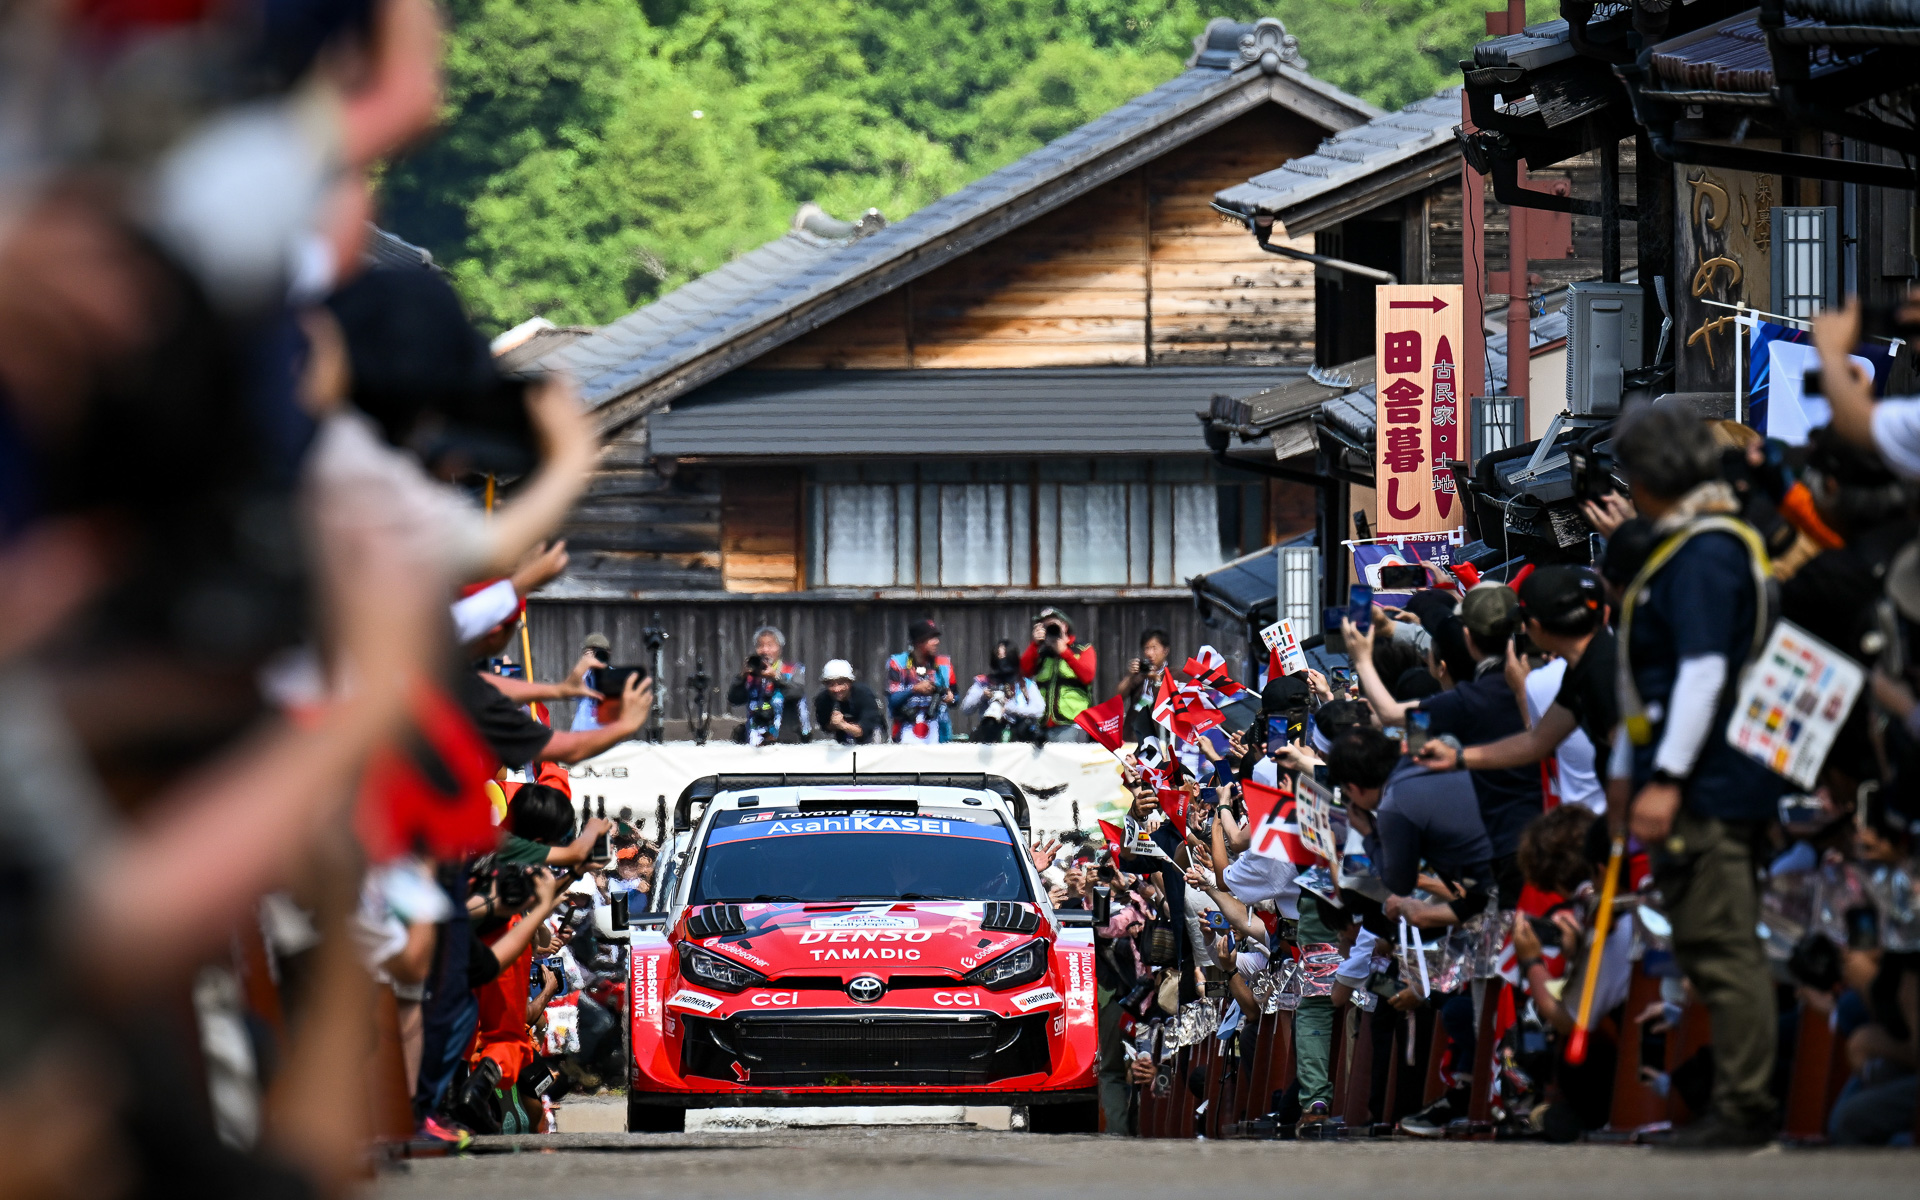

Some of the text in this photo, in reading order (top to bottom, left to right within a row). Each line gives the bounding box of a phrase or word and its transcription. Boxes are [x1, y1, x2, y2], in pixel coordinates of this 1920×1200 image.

[1381, 330, 1425, 520] 田舎暮し
[1431, 359, 1457, 494] 古民家・土地
[779, 810, 848, 818] TOYOTA
[799, 929, 933, 944] DENSO
[809, 948, 922, 961] TAMADIC
[634, 956, 645, 1018] AUTOMOTIVE
[647, 955, 660, 1015] Panasonic
[751, 991, 798, 1006] CCI
[933, 991, 980, 1006] CCI
[1066, 952, 1081, 1010] Panasonic
